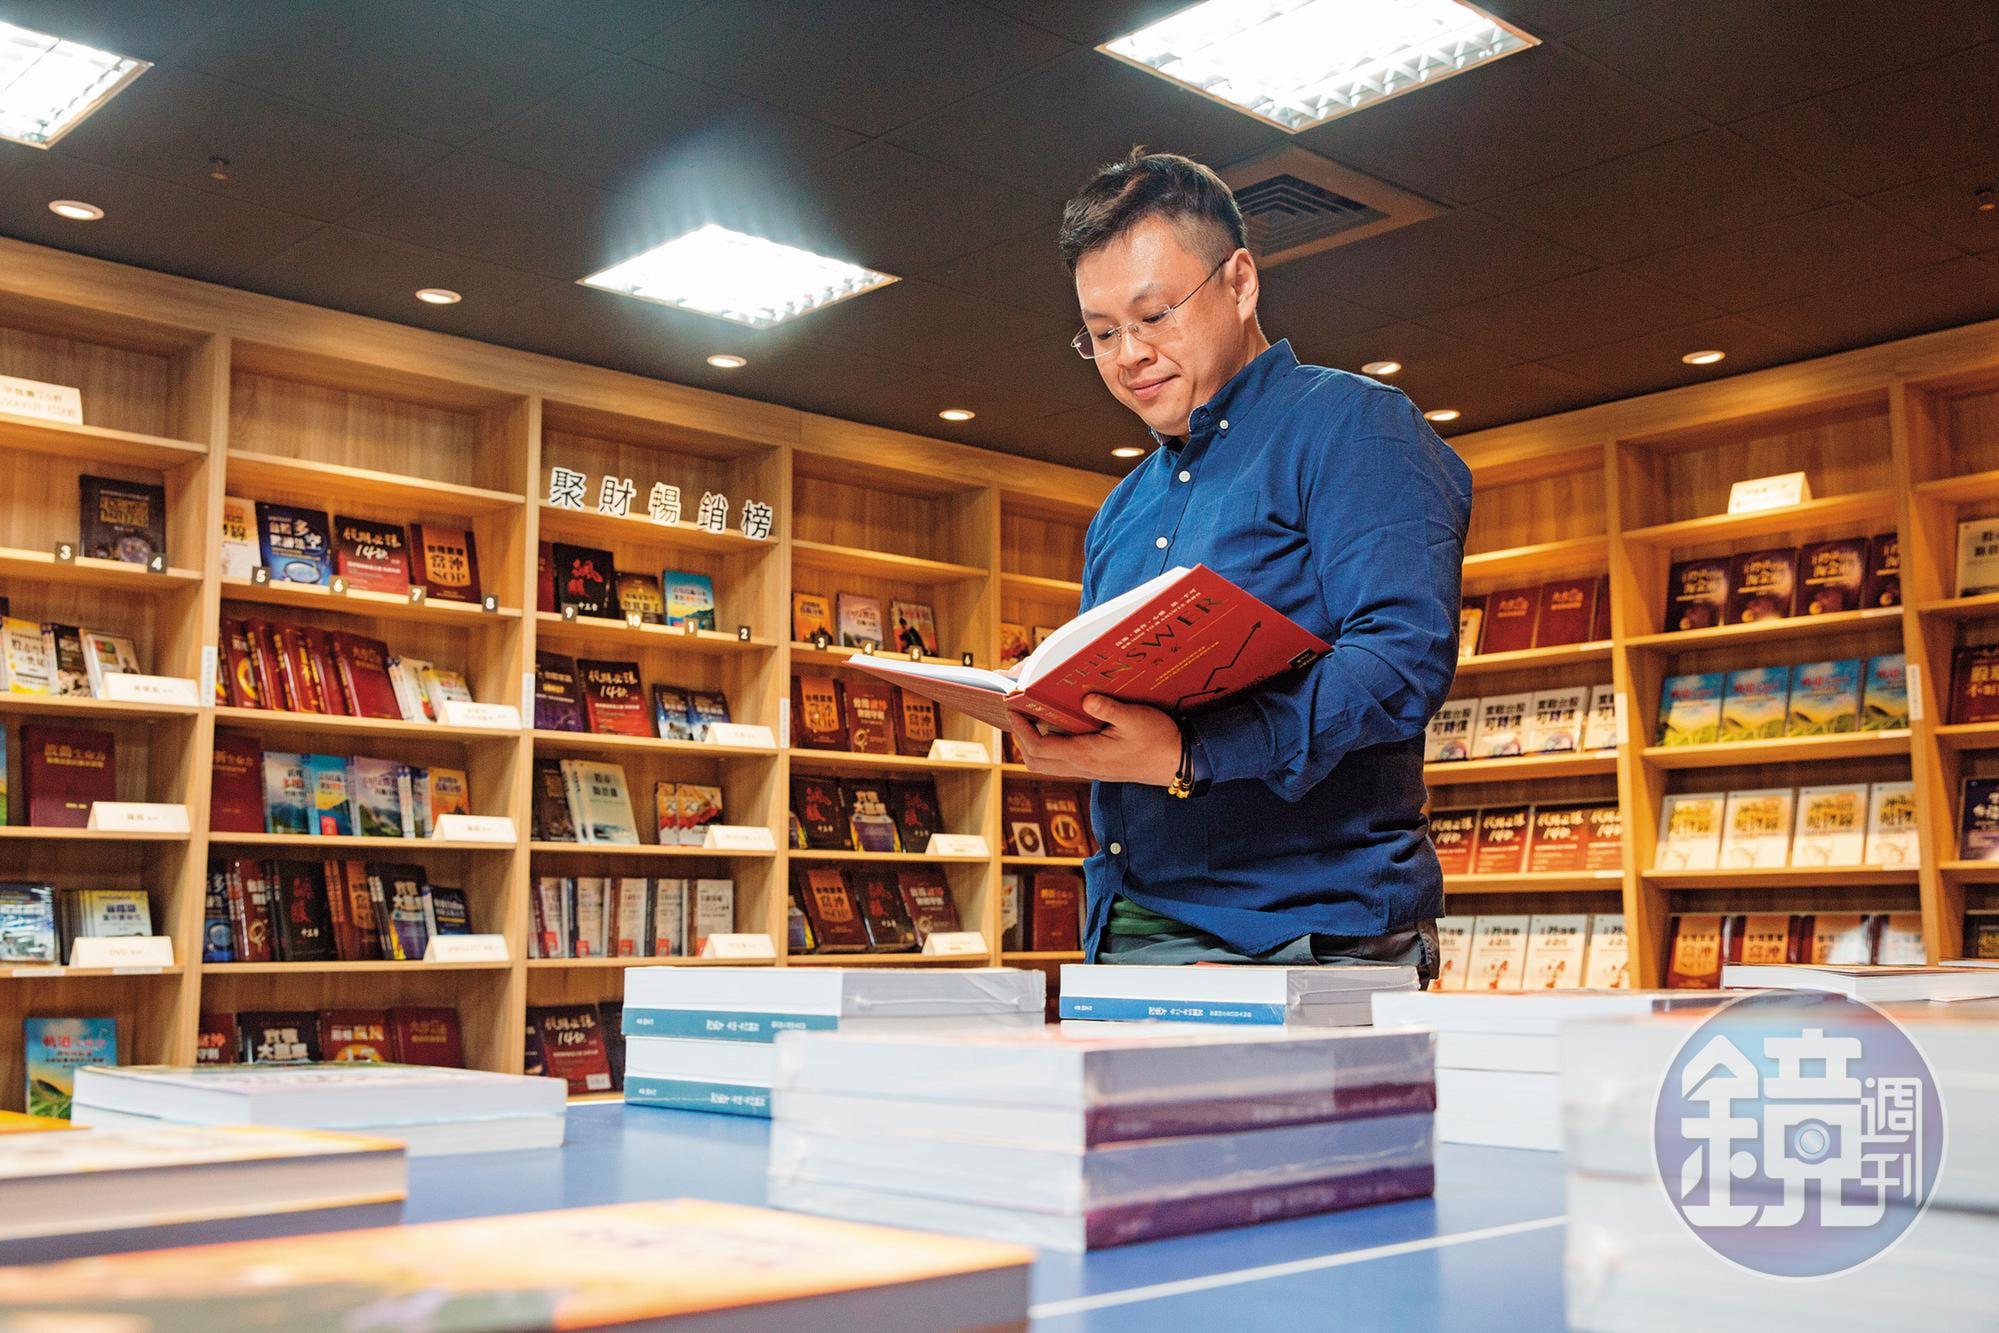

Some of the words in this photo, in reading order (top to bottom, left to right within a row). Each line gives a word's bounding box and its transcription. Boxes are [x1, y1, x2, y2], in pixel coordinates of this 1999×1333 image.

[550, 468, 772, 540] 聚財暢銷榜
[59, 544, 72, 560] 3
[151, 556, 163, 571] 4
[256, 570, 266, 583] 5
[432, 570, 466, 582] SOP
[334, 579, 344, 592] 6
[412, 588, 422, 602] 7
[486, 597, 495, 610] 8
[565, 608, 574, 618] 9
[628, 614, 641, 627] 10
[688, 621, 694, 632] 1
[740, 628, 748, 639] 2
[818, 637, 825, 648] 3
[864, 643, 872, 654] 4
[912, 648, 919, 660] 5
